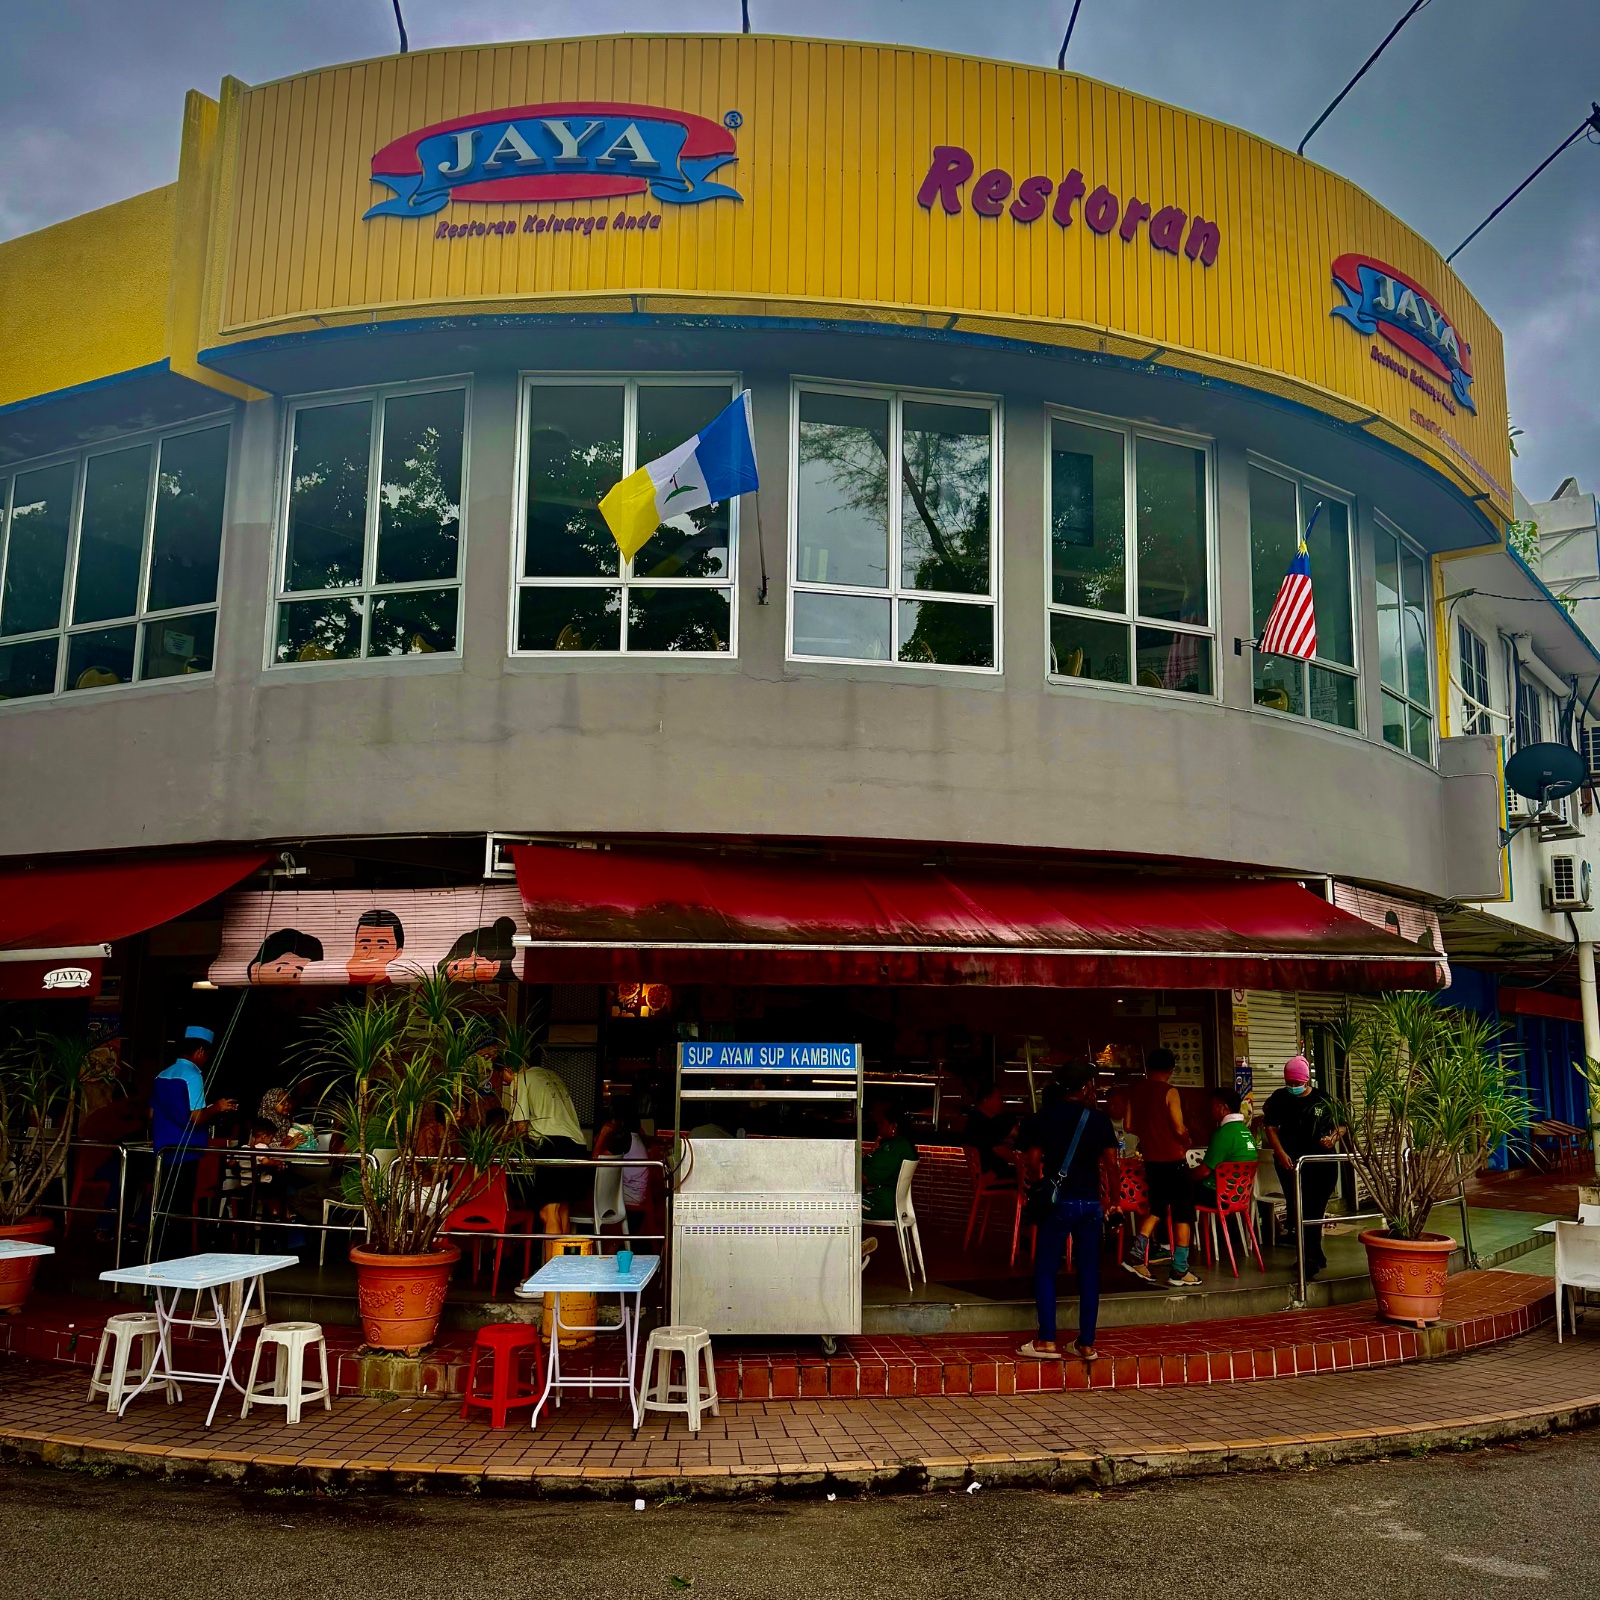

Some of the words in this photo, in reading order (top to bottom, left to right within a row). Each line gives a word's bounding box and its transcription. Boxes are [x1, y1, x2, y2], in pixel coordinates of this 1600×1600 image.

[437, 119, 661, 179] JAYA
[435, 217, 517, 239] Restoran
[523, 213, 608, 236] Keluarga
[613, 211, 662, 230] Anda
[917, 145, 1222, 268] Restoran
[1372, 275, 1463, 369] JAYA
[54, 972, 83, 982] JAYA
[688, 1046, 713, 1065] SUP
[720, 1047, 753, 1065] AYAM
[760, 1047, 785, 1065] SUP
[791, 1048, 851, 1066] KAMBING
